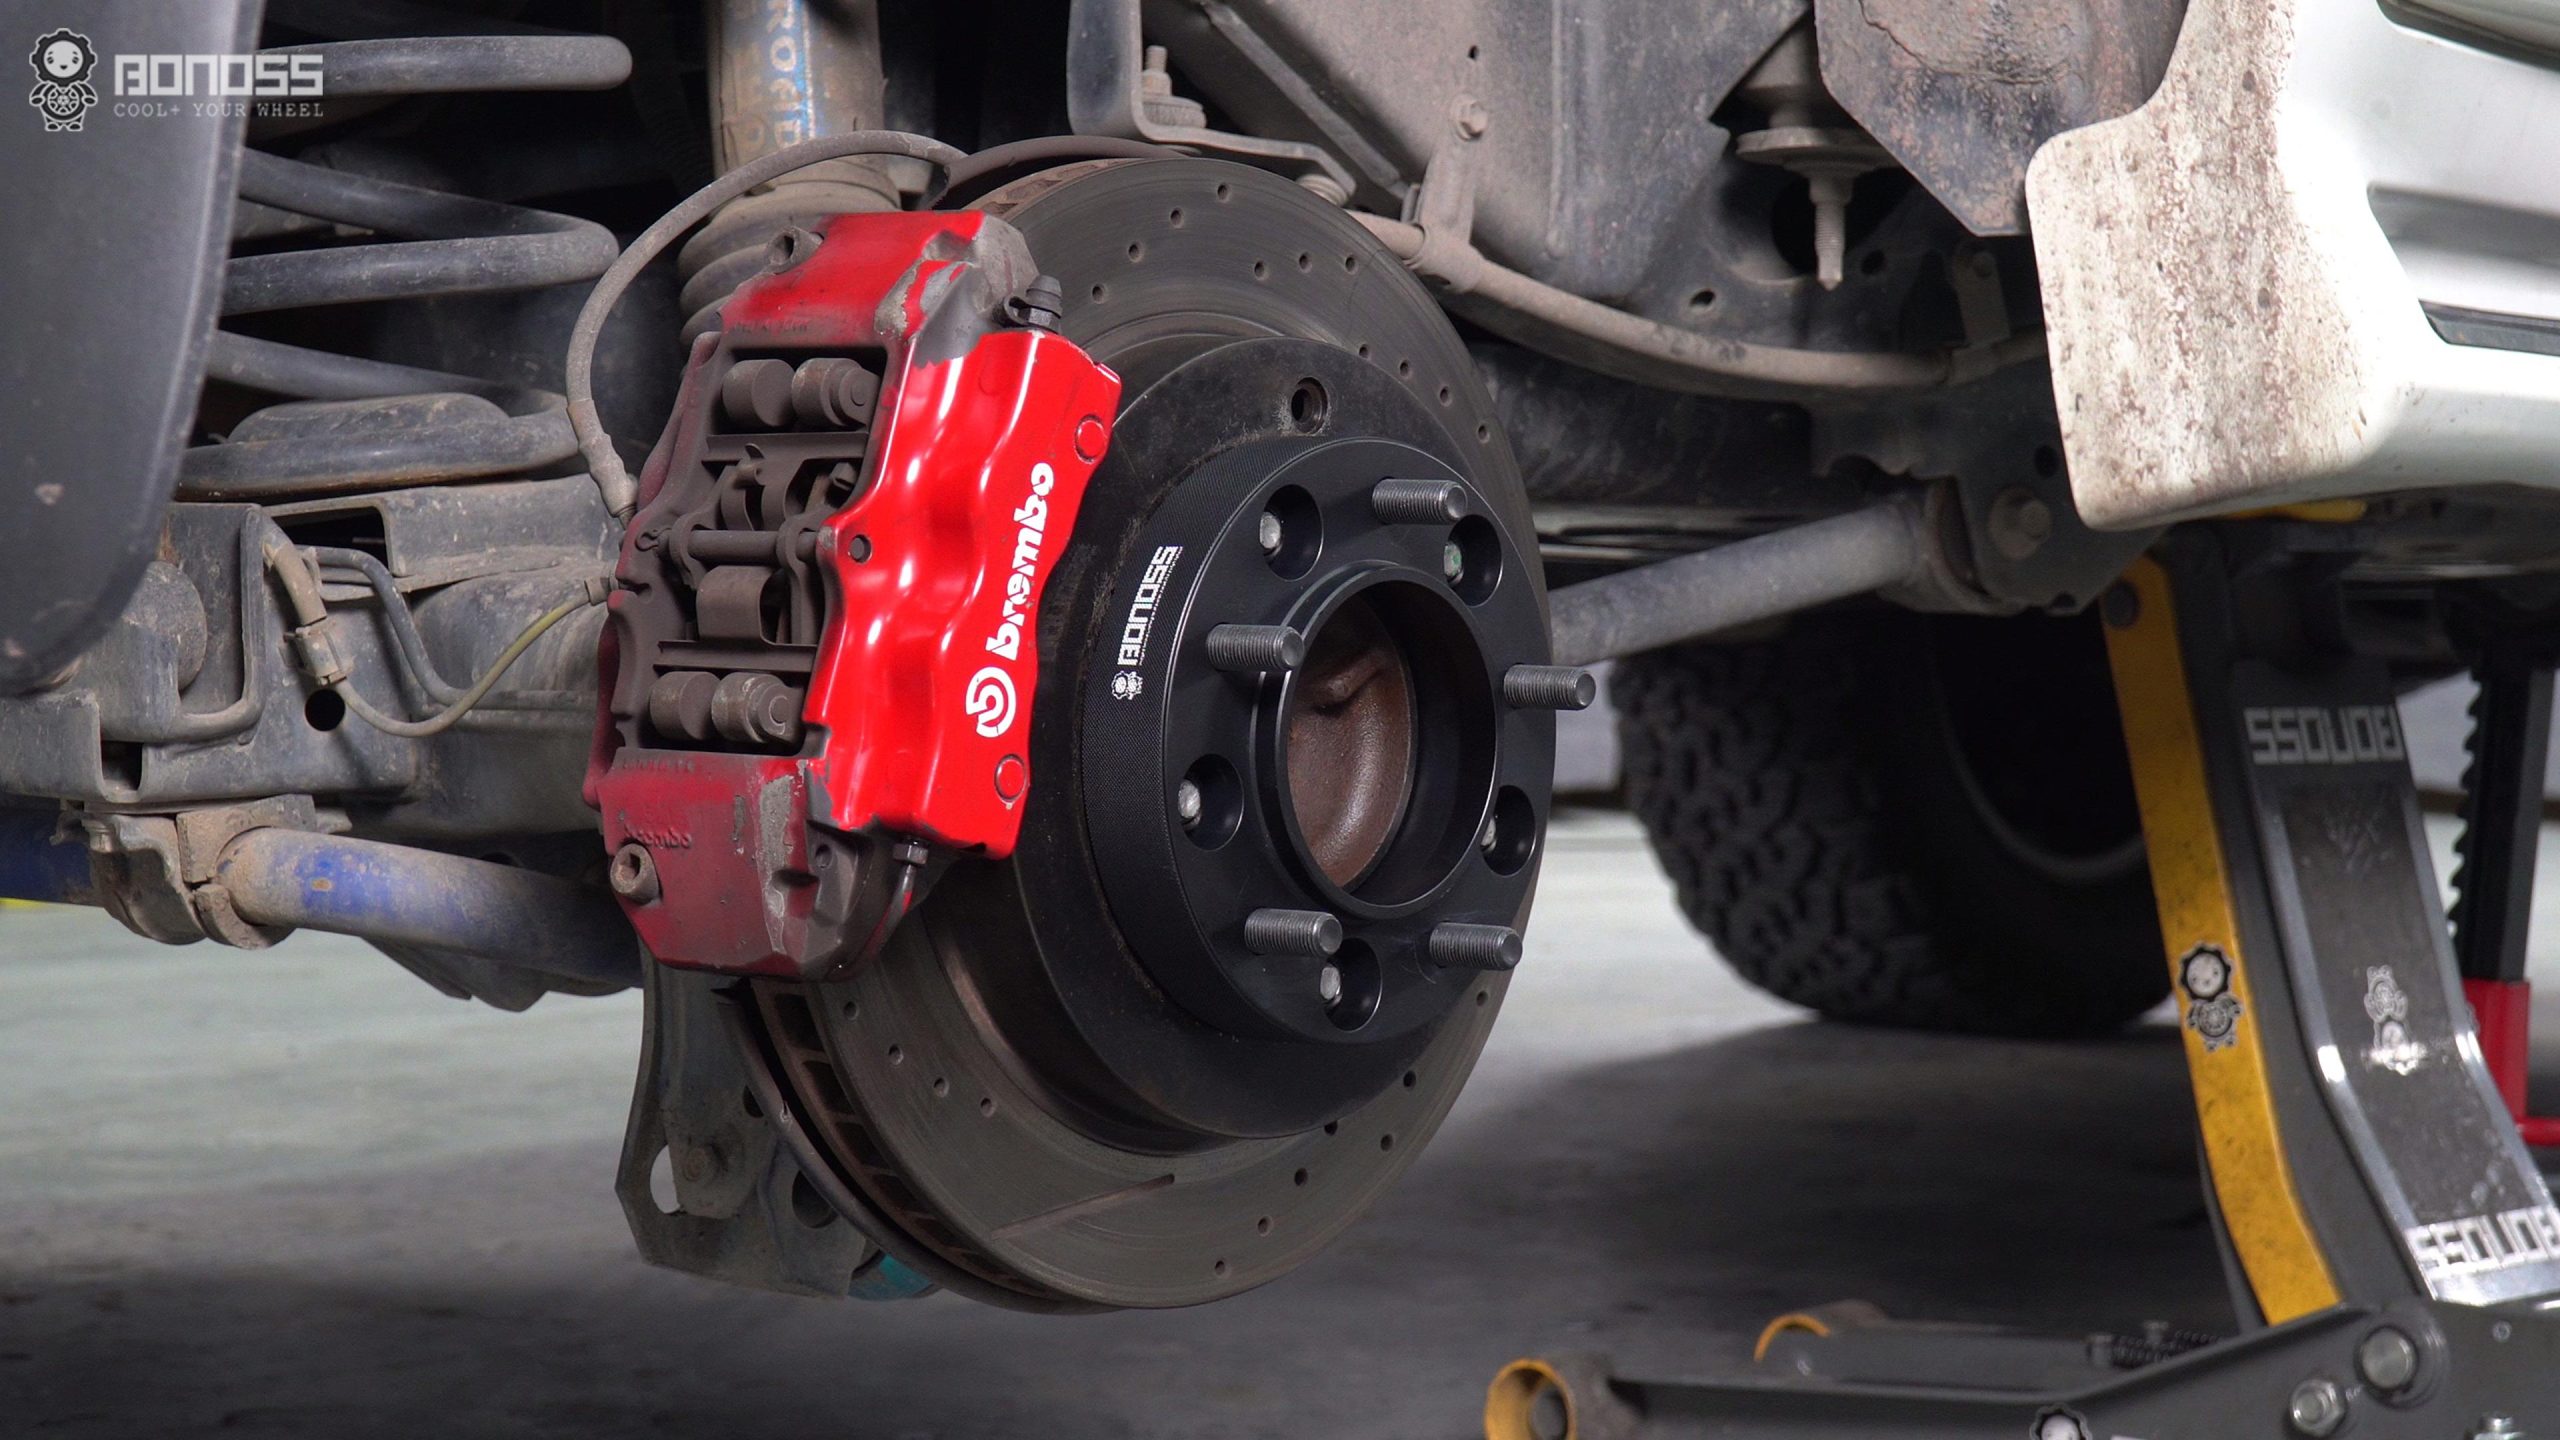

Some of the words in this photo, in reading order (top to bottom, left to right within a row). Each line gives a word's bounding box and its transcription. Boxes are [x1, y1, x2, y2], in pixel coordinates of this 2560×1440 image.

[985, 462, 1054, 661] brembo
[1117, 546, 1179, 666] BONOSS
[2244, 705, 2404, 765] BONOSS
[2403, 1204, 2560, 1281] BONOSS
